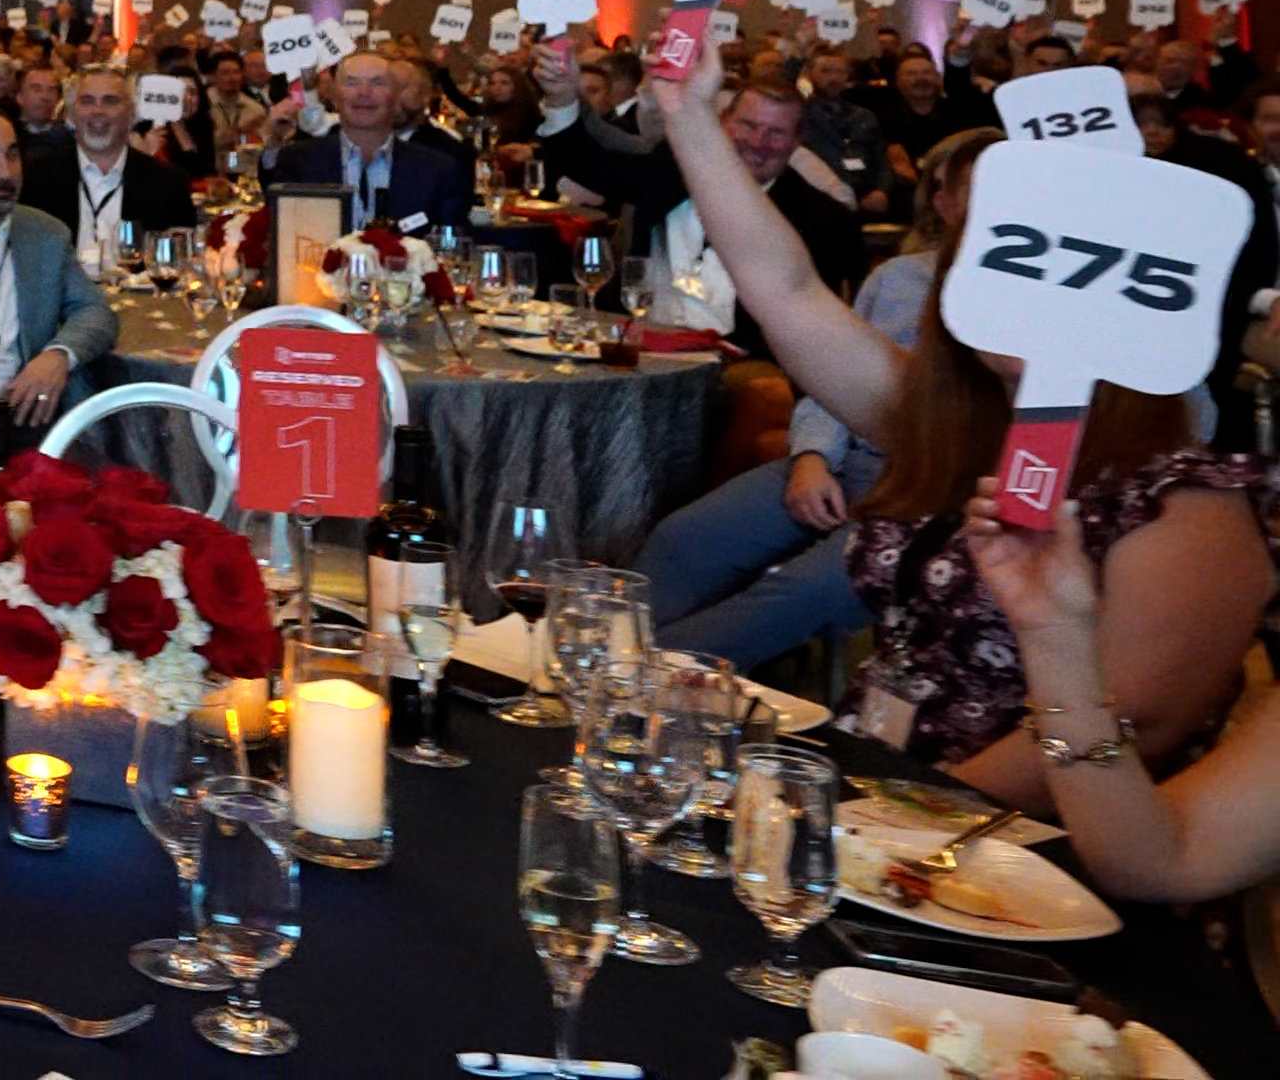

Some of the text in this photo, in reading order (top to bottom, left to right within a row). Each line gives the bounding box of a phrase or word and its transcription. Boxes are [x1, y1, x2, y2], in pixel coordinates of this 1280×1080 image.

[269, 35, 311, 55] 206
[1022, 107, 1116, 140] 132
[980, 224, 1198, 311] 275
[277, 416, 336, 498] 1
